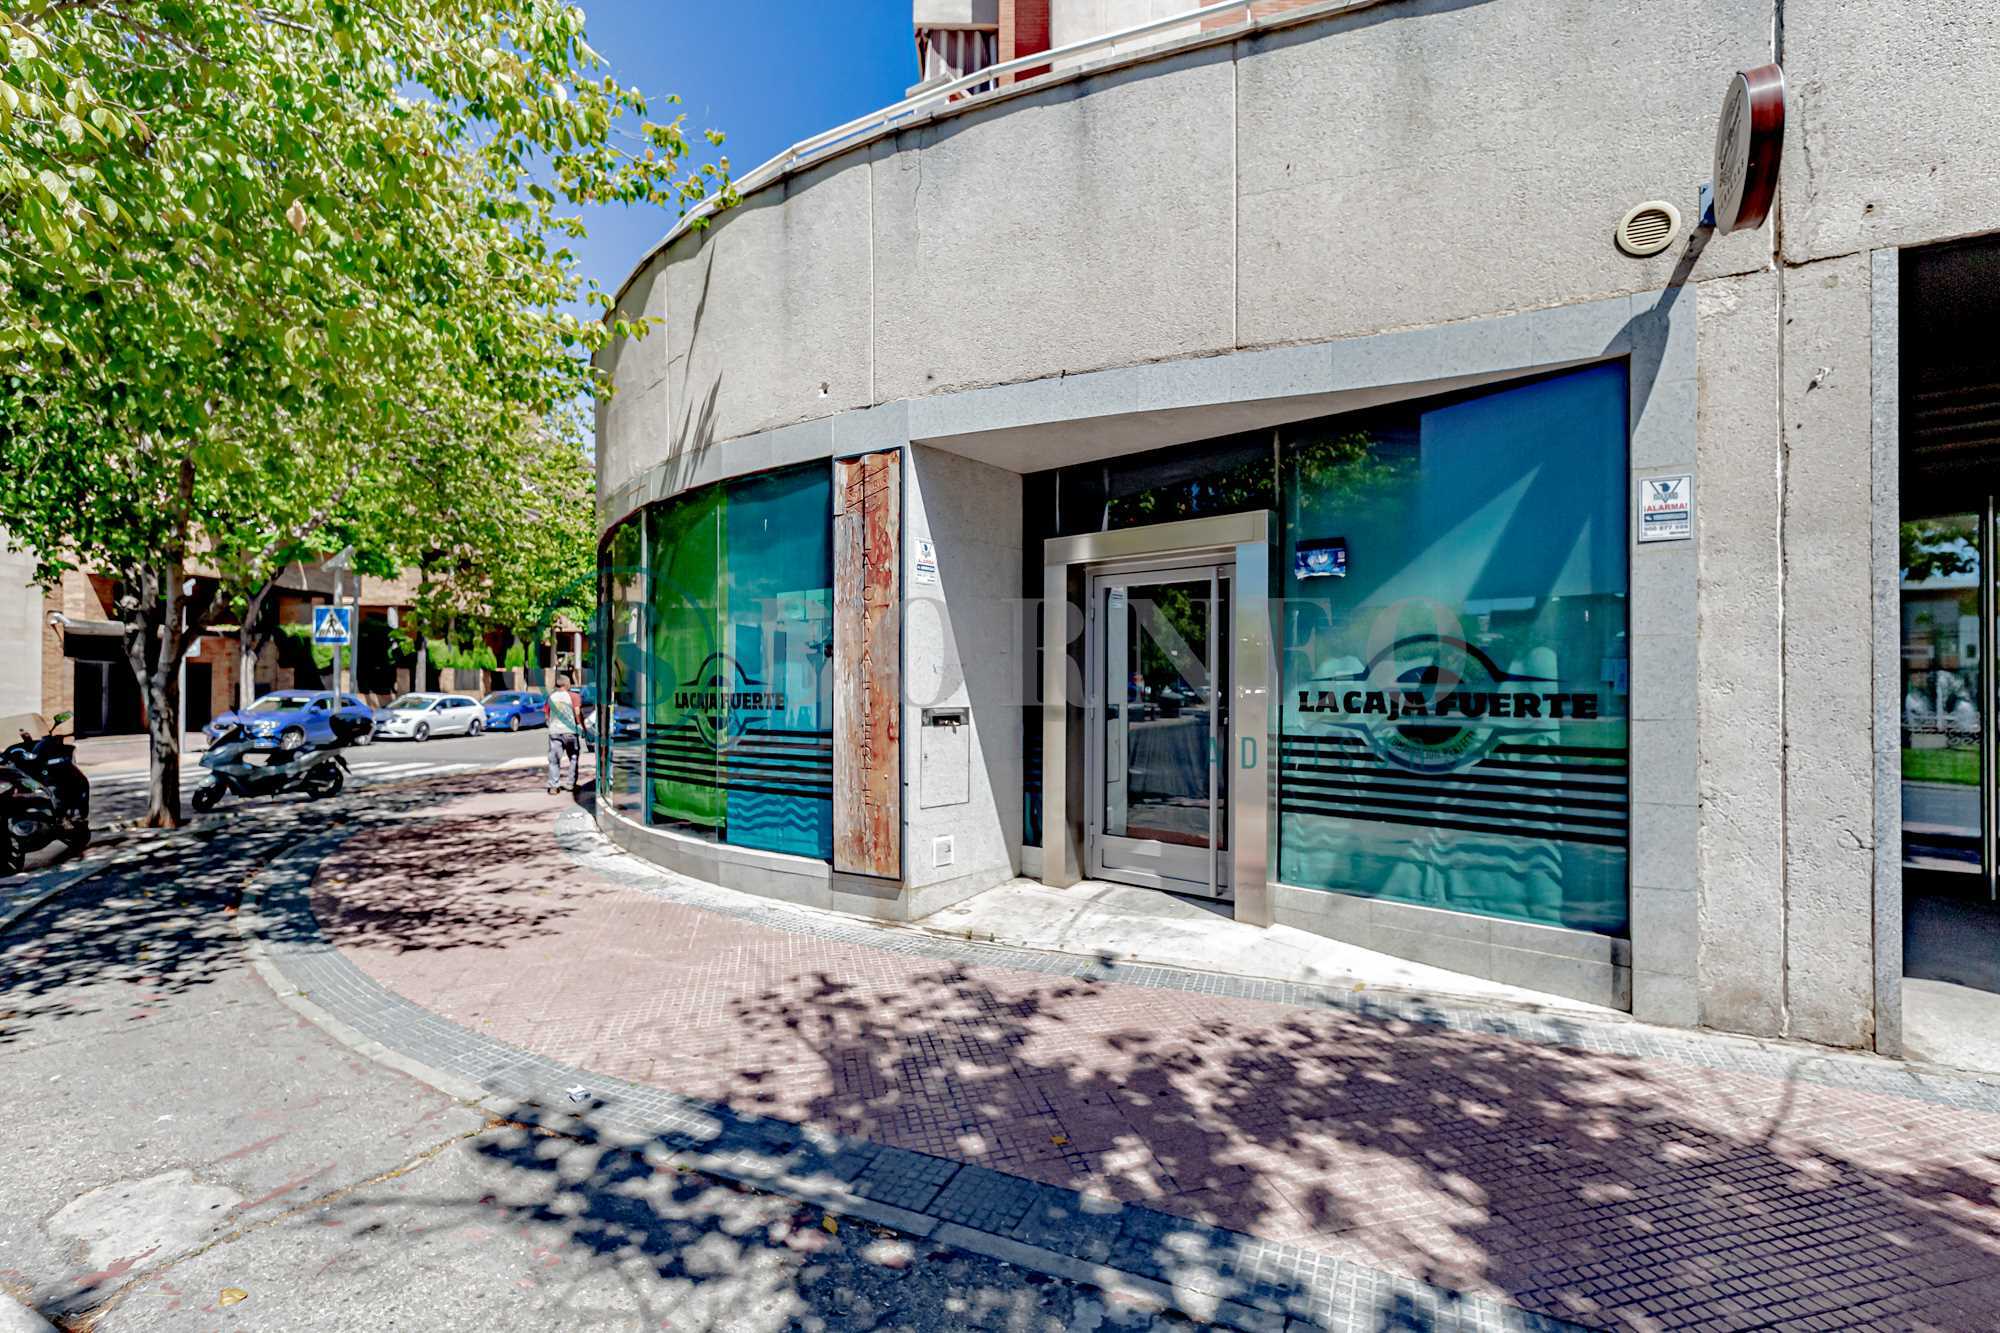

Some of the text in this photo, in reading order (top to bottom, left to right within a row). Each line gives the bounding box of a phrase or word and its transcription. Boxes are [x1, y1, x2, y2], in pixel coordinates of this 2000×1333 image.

[719, 692, 785, 711] FUERTE
[1298, 690, 1598, 721] LA CAJA FUERTE
